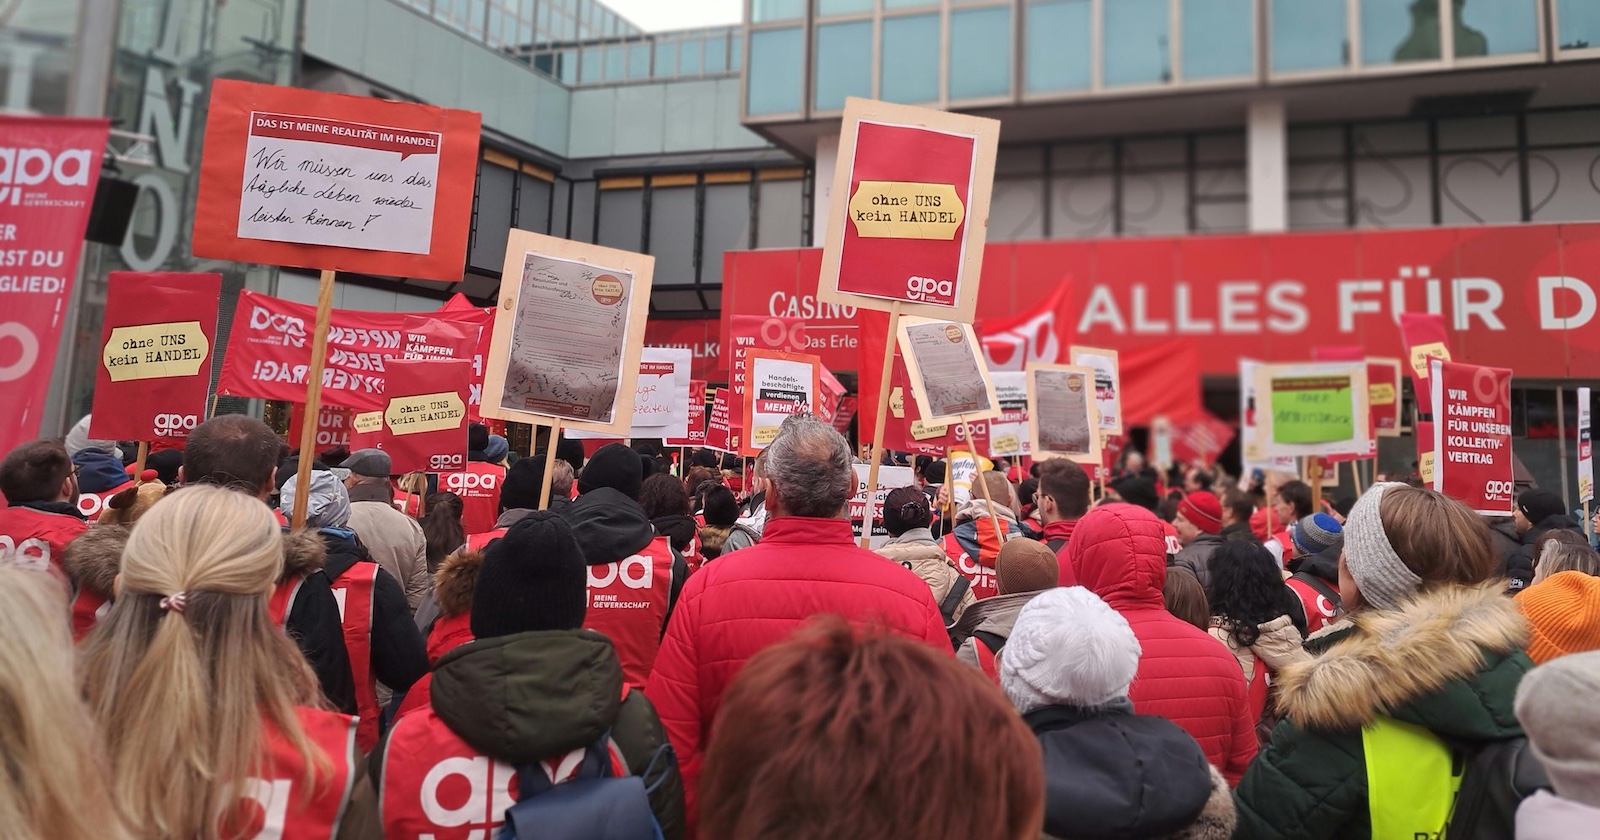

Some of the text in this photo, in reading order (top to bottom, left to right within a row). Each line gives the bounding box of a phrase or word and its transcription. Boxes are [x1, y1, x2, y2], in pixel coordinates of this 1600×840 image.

[256, 118, 436, 148] DAS IST MEINE REALITÄT IM HANDEL
[253, 146, 432, 188] Wir müssen uns das
[313, 183, 361, 204] Leben
[372, 195, 422, 210] wieder
[871, 194, 942, 207] ohne UNS
[248, 205, 295, 224] leisten
[302, 208, 356, 230] können
[856, 210, 957, 224] kein HANDEL
[32, 252, 64, 268] DU
[906, 275, 953, 301] gpa
[769, 291, 858, 319] CASINO
[1077, 281, 1310, 334] ALLES
[1337, 267, 1507, 332] FÜR
[122, 334, 186, 350] ohne UNS
[407, 333, 427, 344] WIR
[736, 337, 755, 346] WIR
[830, 334, 858, 348] Erle
[109, 348, 201, 367] kein HANDEL
[405, 343, 454, 356] KÄMPFEN
[761, 380, 805, 391] beschäftigte
[768, 374, 799, 383] Handels-
[766, 391, 800, 401] verdienen
[1448, 388, 1468, 401] WIR
[400, 400, 449, 414] ohne UNS
[1448, 403, 1496, 419] KÄMPFEN
[153, 413, 198, 437] gpa
[319, 410, 342, 428] ÜR
[390, 409, 461, 426] kein HANDEL
[1448, 418, 1512, 436] FÜR UNSEREN
[1448, 436, 1503, 450] KOLLEKTIV-
[430, 453, 462, 469] gpa
[1448, 451, 1494, 464] VERTRAG
[447, 472, 496, 497] gpa
[1485, 480, 1512, 501] gpa
[593, 601, 651, 609] GEWERKSCHAFT
